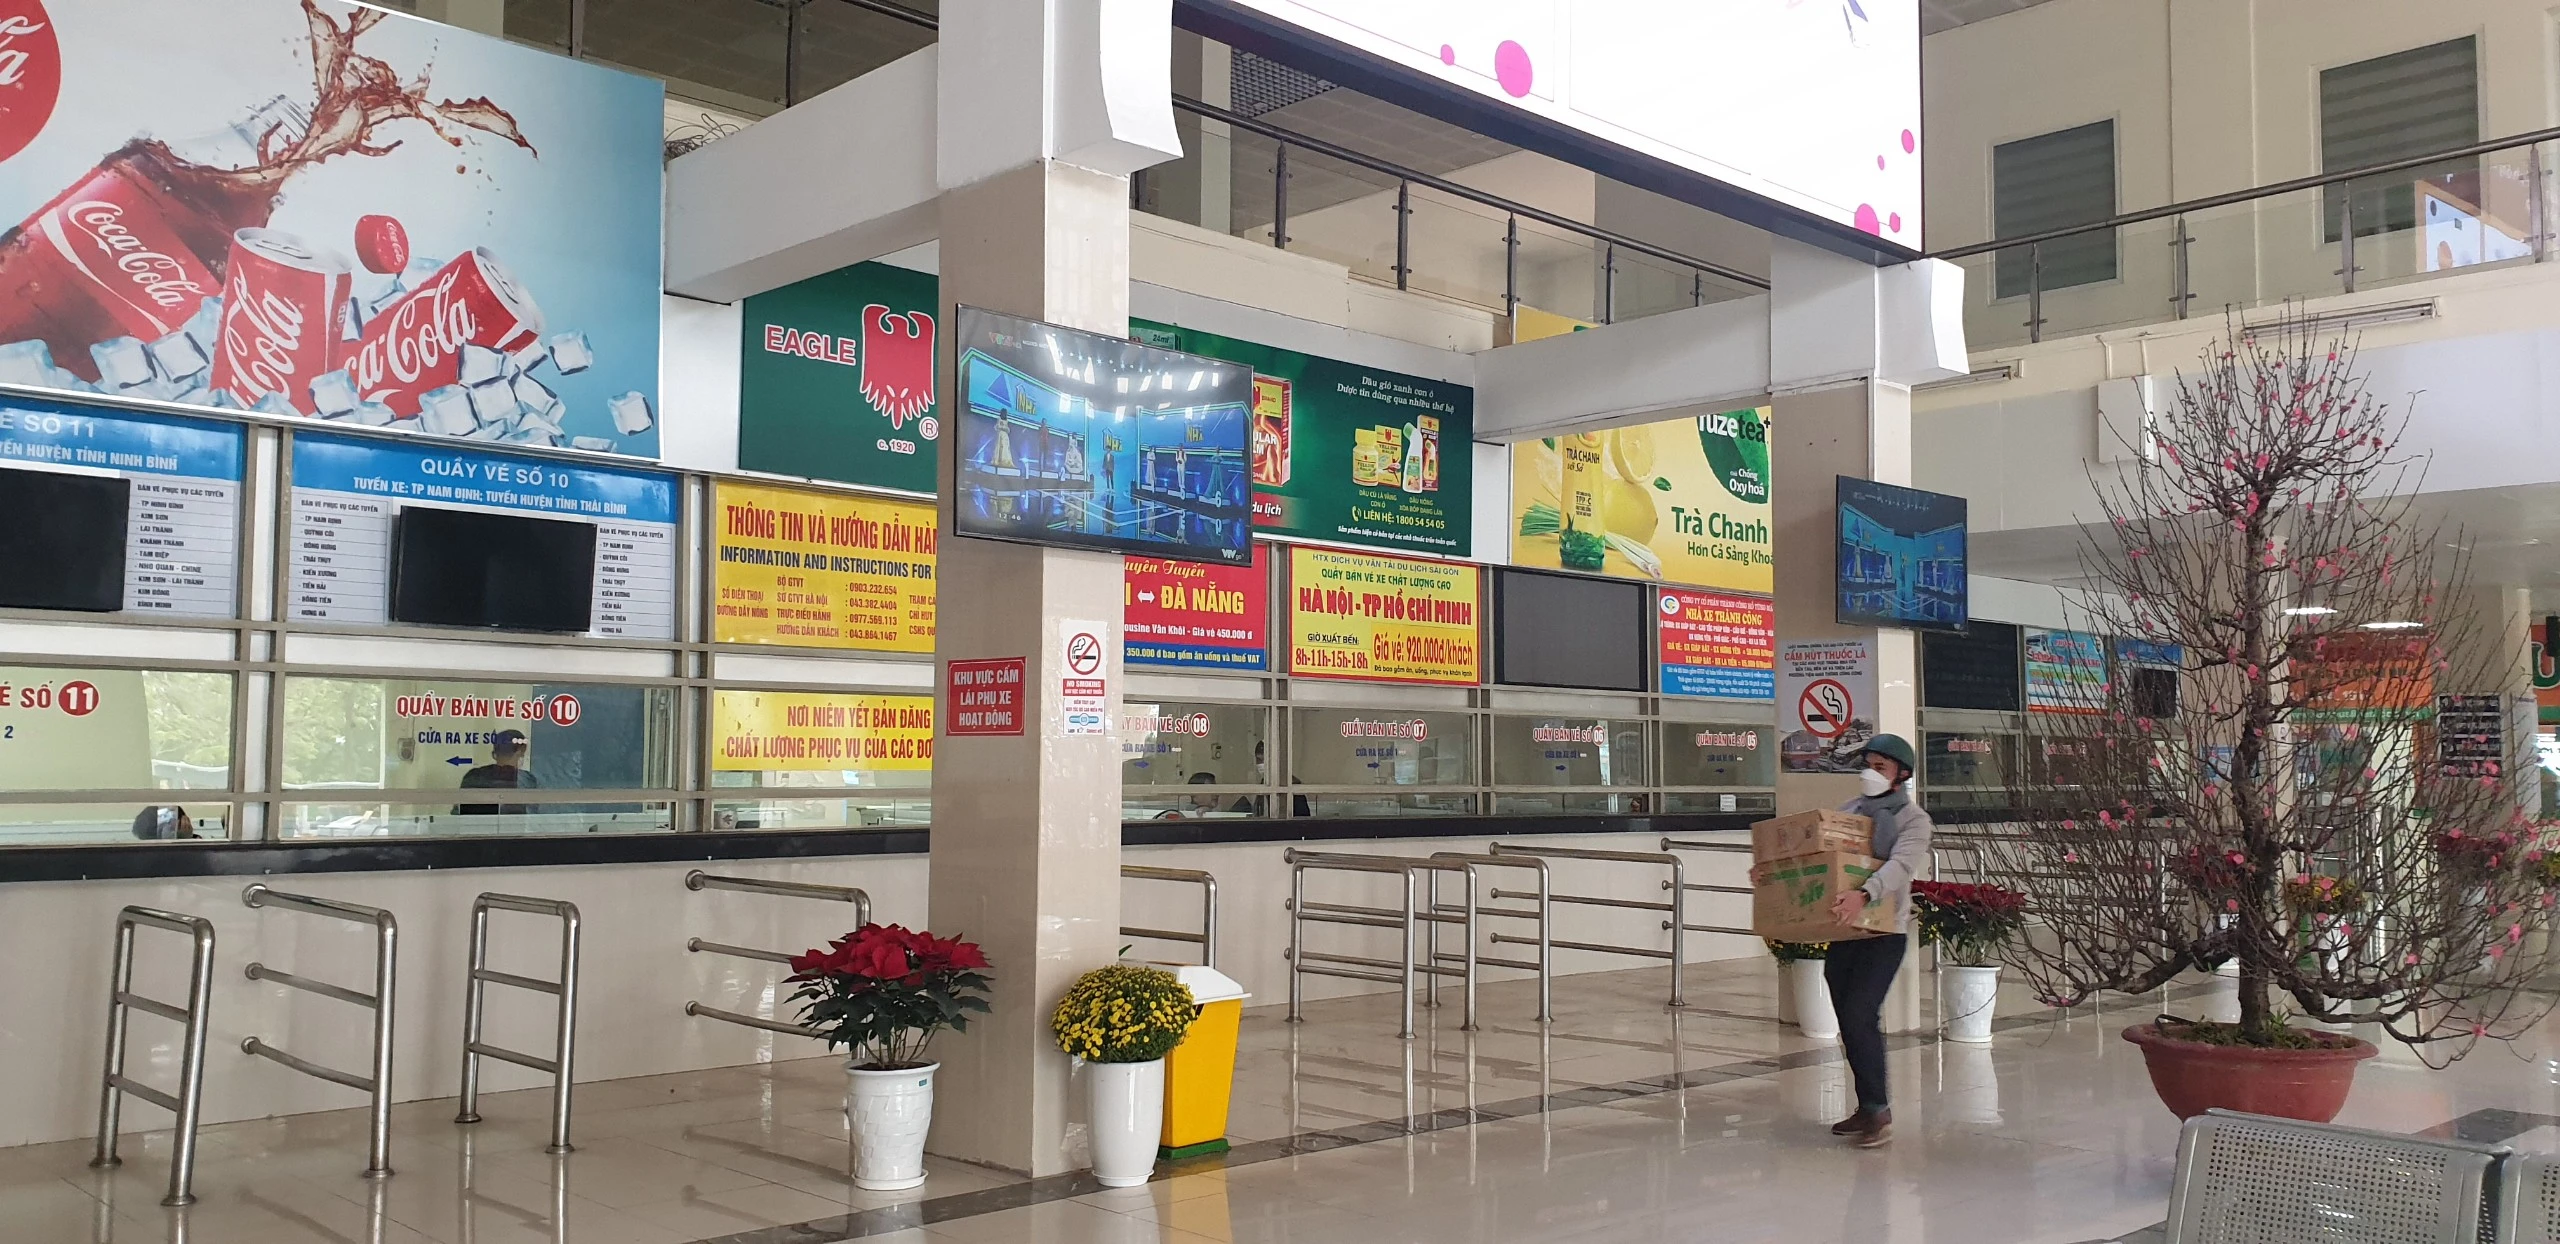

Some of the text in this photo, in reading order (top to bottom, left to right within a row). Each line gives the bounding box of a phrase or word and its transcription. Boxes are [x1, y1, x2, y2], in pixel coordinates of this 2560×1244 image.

[67, 200, 204, 308] Coca-Cola
[765, 324, 856, 366] EAGLE
[25, 410, 60, 434] SỐ
[71, 420, 94, 438] 11
[27, 443, 72, 461] HUYỆN
[76, 447, 106, 463] TỈNH
[110, 454, 142, 467] NINH
[147, 454, 178, 471] BÌNH
[877, 439, 915, 454] c. 1920
[1566, 446, 1600, 464] TRÀ CHANH
[484, 463, 509, 482] VÉ
[516, 465, 542, 486] SỐ
[549, 473, 568, 488] 10
[1739, 468, 1757, 481] Chống
[391, 483, 408, 494] XE:
[411, 483, 424, 495] TP
[427, 485, 452, 498] NAM
[580, 499, 601, 512] THÁI
[604, 501, 626, 514] BÌNH
[1730, 479, 1764, 496] Oxy hoá
[1265, 503, 1281, 517] lịch
[1364, 510, 1444, 529] LIÊN HỆ: 1800 54 54 05
[727, 501, 775, 539] THÔNG
[781, 512, 804, 541] TIN
[808, 510, 826, 544] VÀ
[831, 511, 878, 549] HƯỚNG
[883, 513, 910, 552] DẪN
[1672, 507, 1767, 544] Trà Chanh
[721, 546, 931, 579] INFORMATION AND INSTRUCTIONS FOR
[1312, 554, 1328, 562] HTX
[1331, 556, 1350, 564] DỊCH
[1353, 558, 1363, 567] VỤ
[1410, 564, 1427, 573] LỊCH
[1688, 541, 1708, 557] Hơn
[1712, 542, 1723, 559] Cả
[1726, 545, 1749, 566] Sảng
[778, 575, 804, 590] BỘ GTVT
[1346, 570, 1362, 581] BÁN
[1365, 571, 1373, 582] VÉ
[1376, 574, 1385, 583] XE
[1437, 581, 1451, 589] CAO
[1161, 581, 1244, 614] ĐÀ NẴNG
[1300, 583, 1324, 613] HÀ
[1327, 586, 1353, 619] NỘI
[1363, 593, 1381, 617] TP
[1384, 589, 1404, 620] HỒ
[1407, 594, 1432, 621] CHÍ
[1435, 600, 1471, 625] MINH
[1686, 606, 1762, 625] NHÀ XE THÀNH CÔNG
[1308, 633, 1321, 642] GIỜ
[1322, 634, 1341, 643] XUẤT
[1374, 632, 1389, 660] Giá
[1392, 634, 1404, 660] vé:
[1296, 647, 1368, 669] 8h-11h-15h-18h
[1784, 649, 1802, 660] CẤM
[1823, 648, 1852, 659] THUỐC
[954, 665, 1018, 687] KHU VỰC CẤM
[396, 691, 578, 721] QUẦY BÁN VÉ SỐ 10
[960, 689, 1011, 707] LÁI PHỤ XE
[788, 700, 930, 729] NƠI NIÊM YẾT BẢN ĐĂNG
[959, 709, 1012, 728] HOẠT ĐỘNG
[418, 727, 478, 744] CỬA RA XE
[1366, 720, 1384, 736] BÁN
[1386, 721, 1397, 737] VÉ
[1400, 720, 1412, 738] SỐ
[1414, 723, 1424, 737] 07
[727, 729, 759, 757] CHẤT
[763, 735, 804, 763] LƯỢNG
[809, 738, 841, 762] PHỤC
[846, 738, 860, 762] VỤ
[865, 730, 887, 758] CỦA
[891, 734, 913, 758] CÁC
